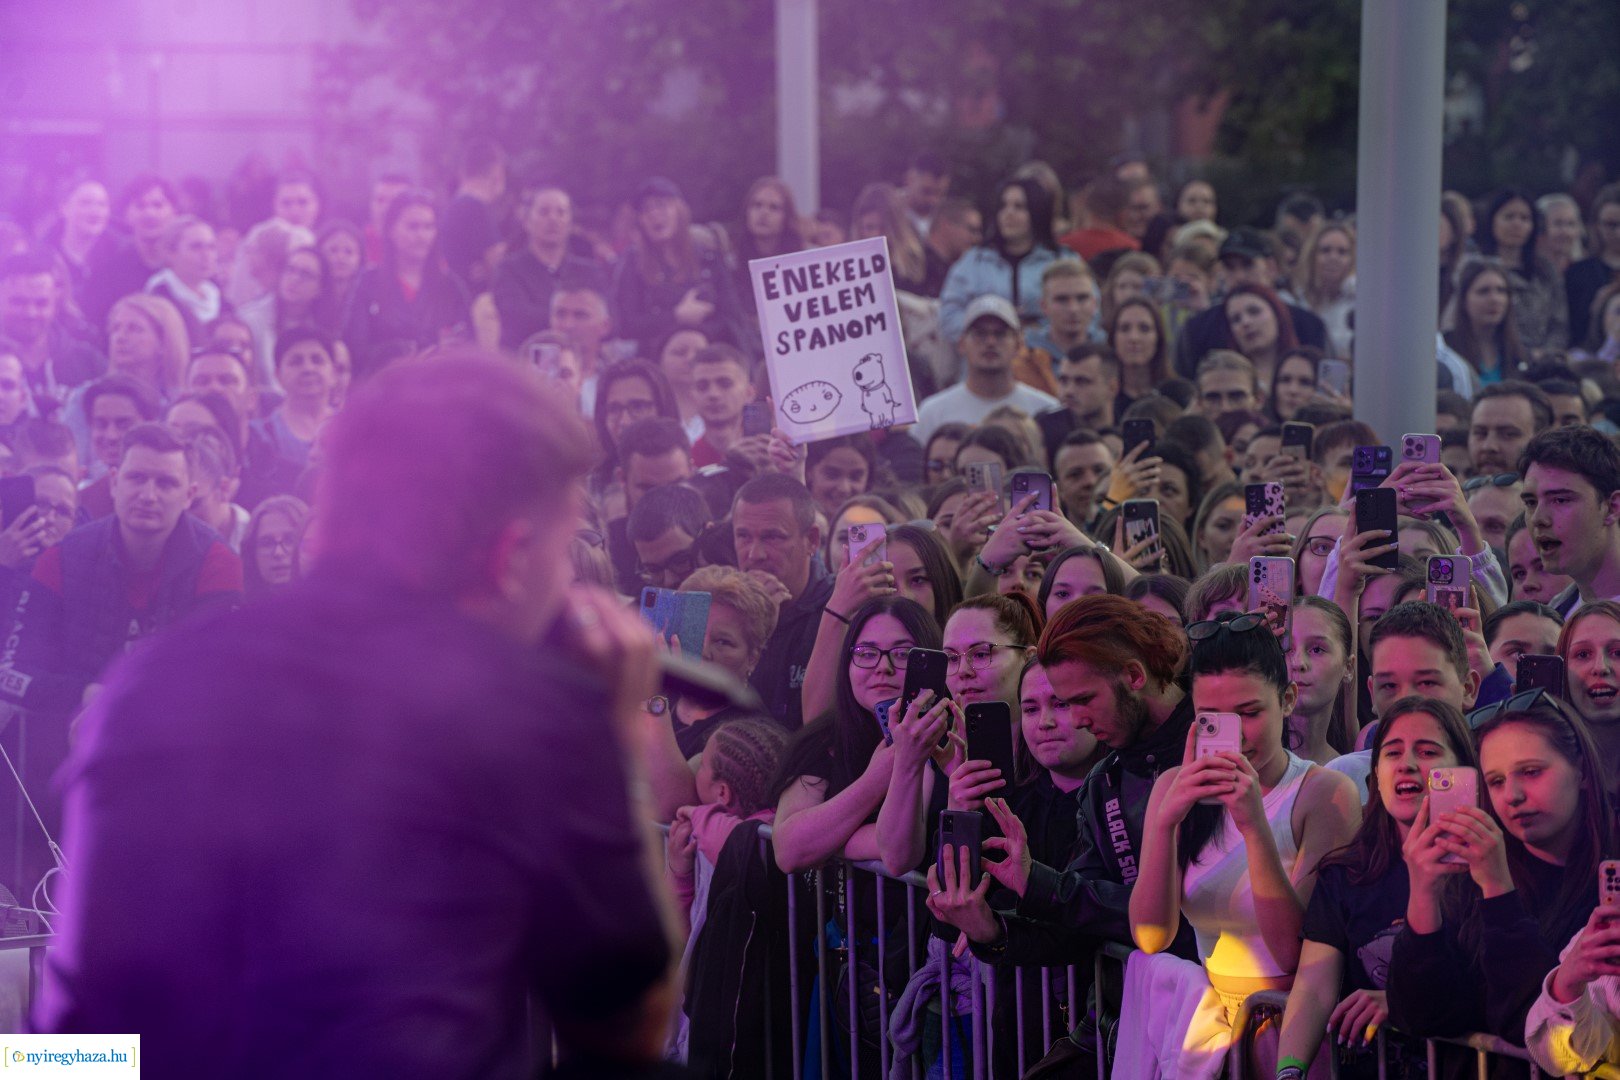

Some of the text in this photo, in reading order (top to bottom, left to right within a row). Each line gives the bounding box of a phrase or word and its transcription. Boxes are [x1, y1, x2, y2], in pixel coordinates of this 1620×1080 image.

[762, 254, 886, 300] ÉNEKELD
[783, 282, 876, 323] VELEM
[776, 312, 887, 355] SPANOM
[1105, 798, 1132, 854] BLACK
